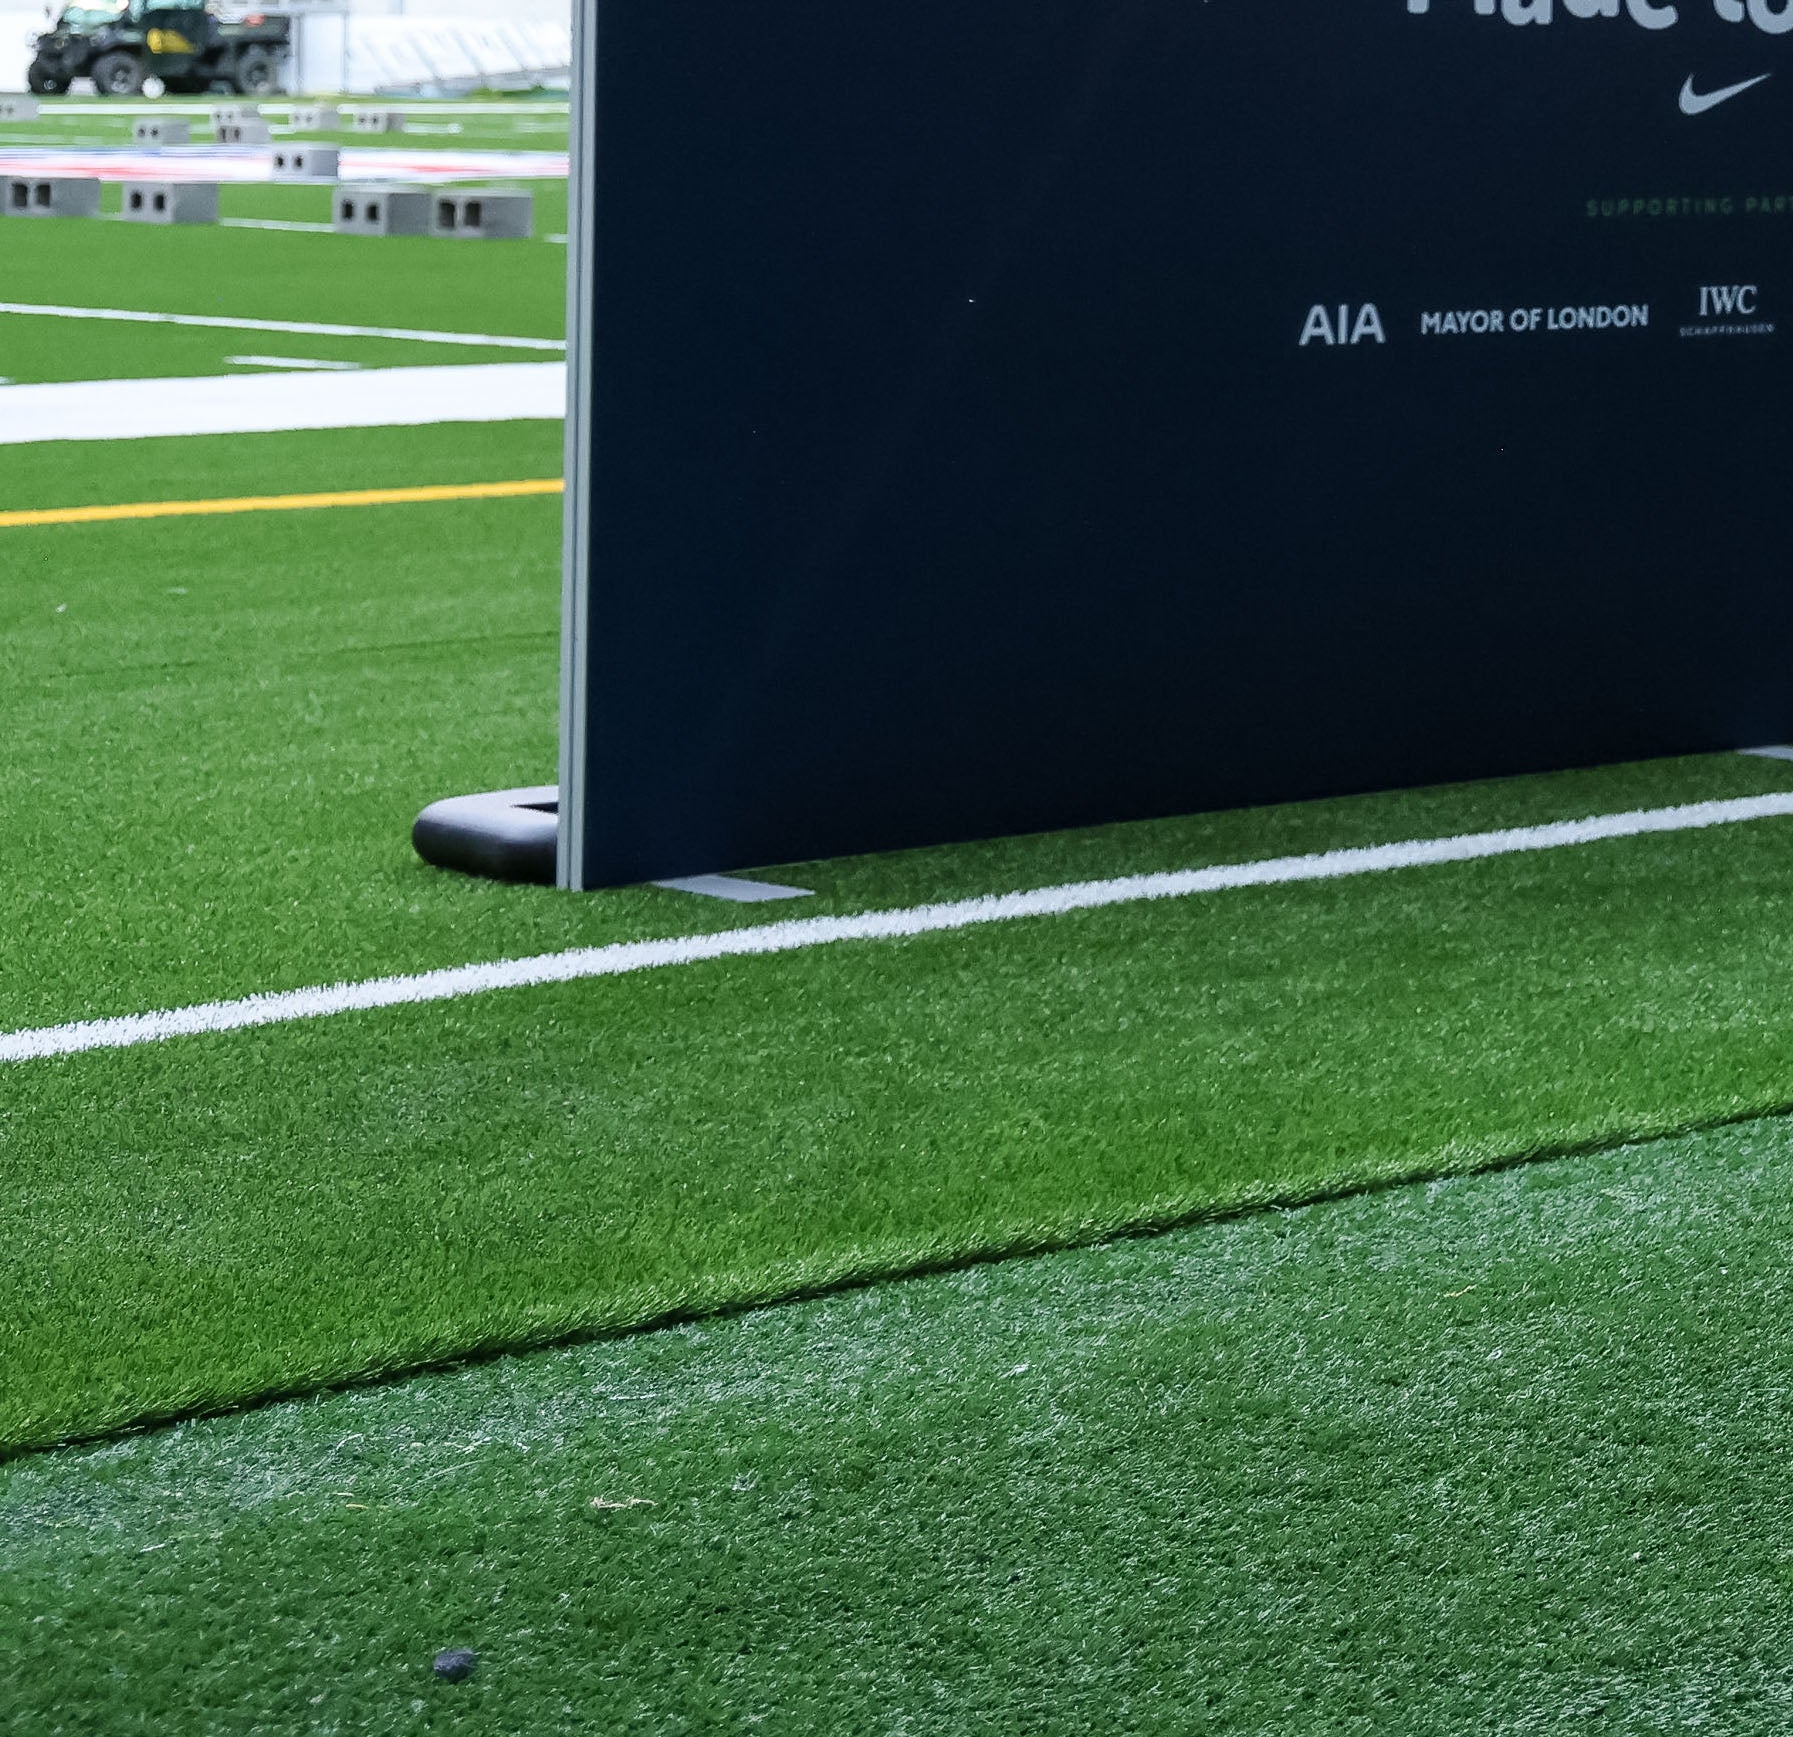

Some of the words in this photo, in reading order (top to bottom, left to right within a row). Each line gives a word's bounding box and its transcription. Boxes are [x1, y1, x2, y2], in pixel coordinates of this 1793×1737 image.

[1586, 197, 1733, 217] SUPPORTING
[1699, 285, 1757, 316] IWC
[1299, 302, 1386, 346] AIA
[1421, 310, 1504, 335] MAYOR
[1509, 307, 1543, 332] OF
[1547, 304, 1649, 330] LONDON
